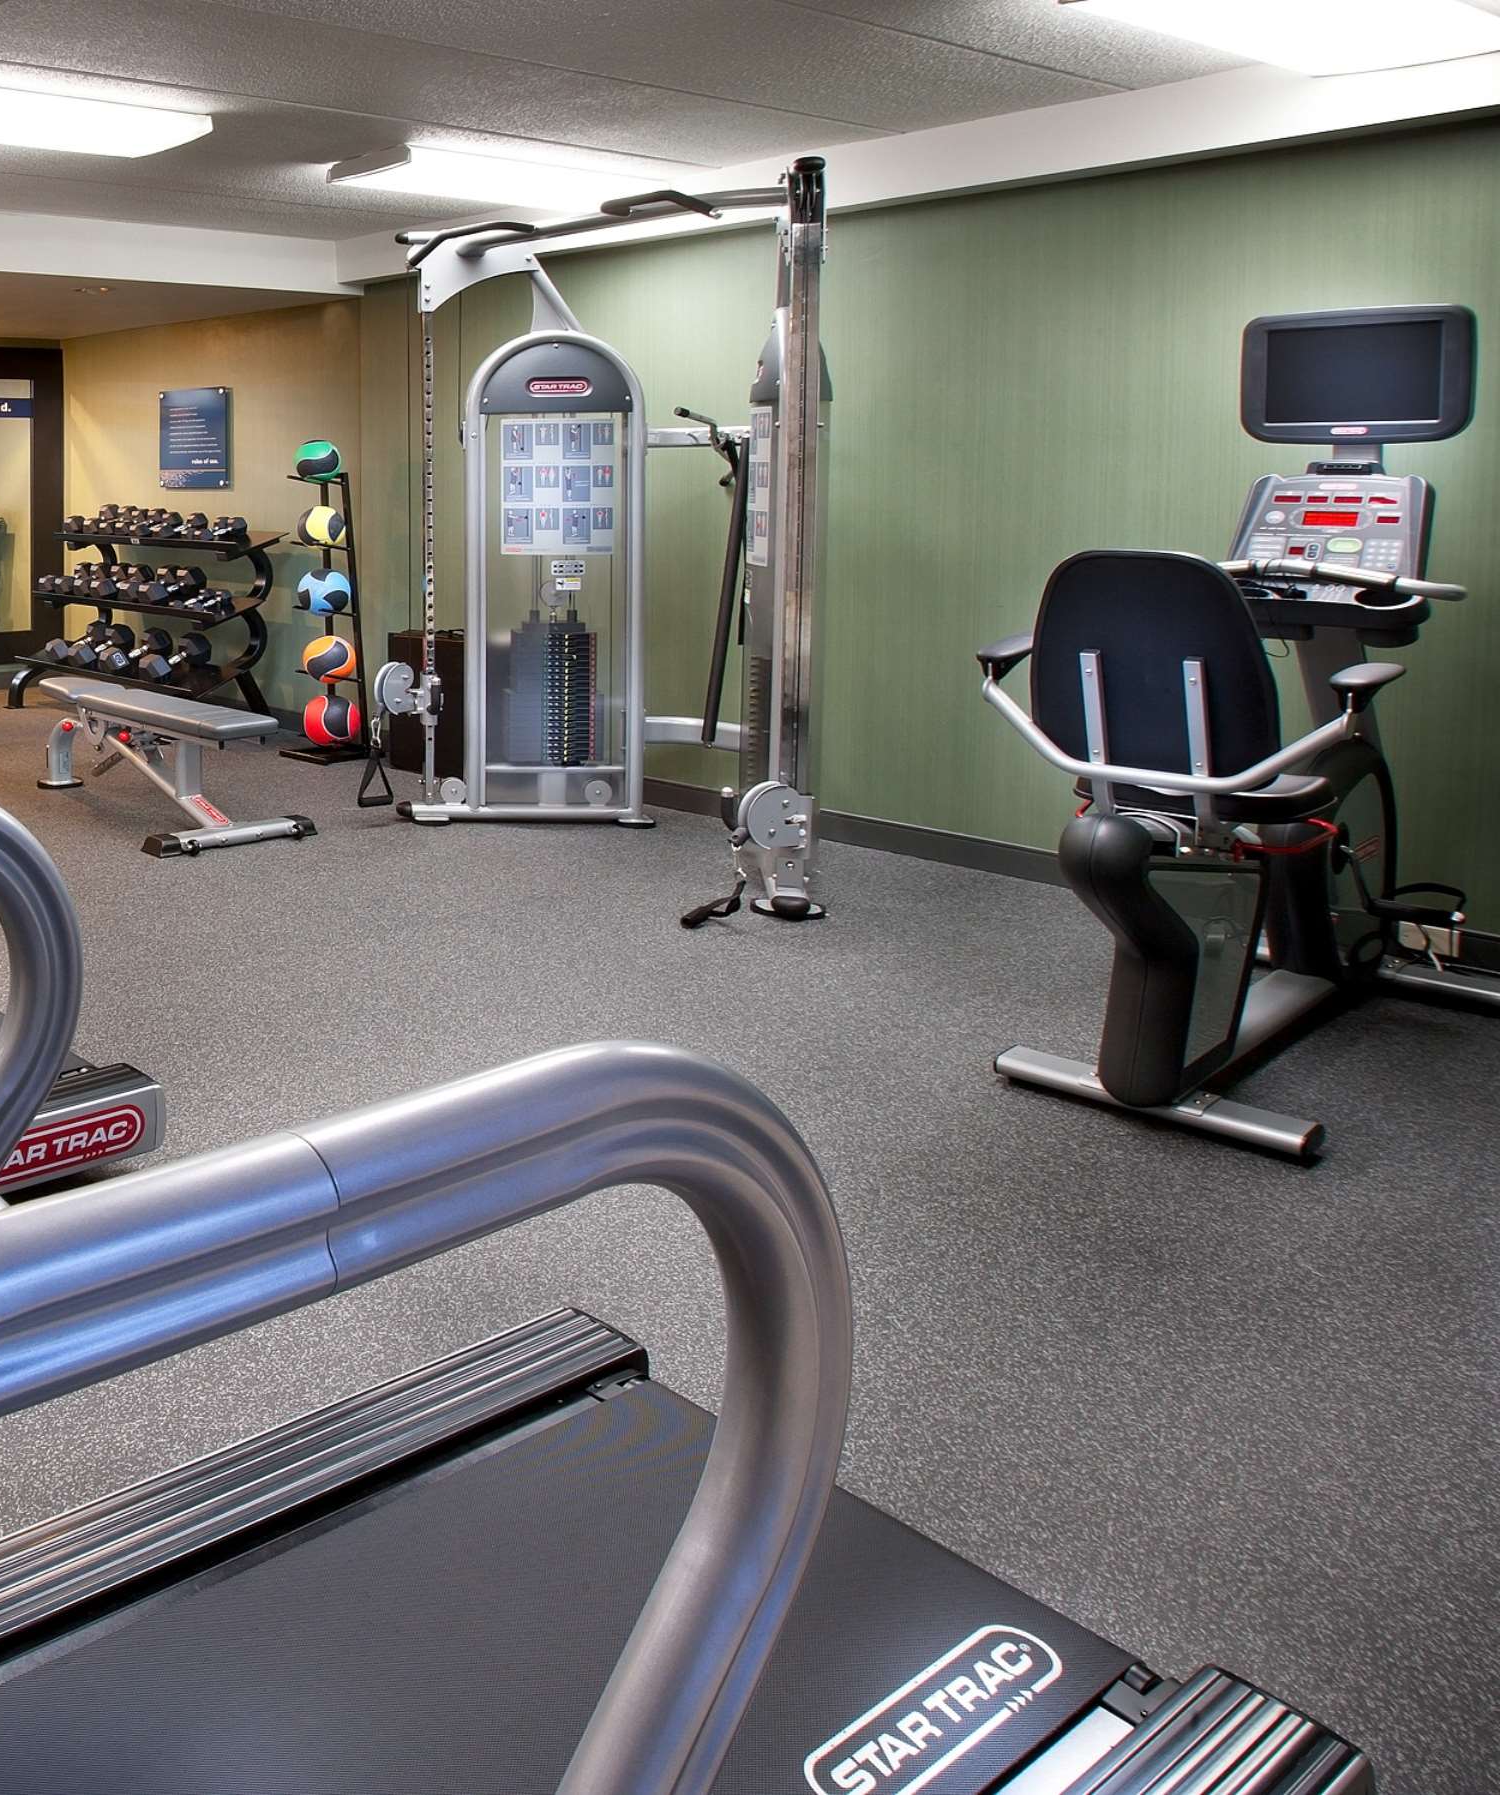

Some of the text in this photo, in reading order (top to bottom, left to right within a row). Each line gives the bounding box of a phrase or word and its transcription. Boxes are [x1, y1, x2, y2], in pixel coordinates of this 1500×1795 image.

[3, 1120, 129, 1170] AR TRAC
[830, 1641, 1034, 1795] STAR TRAC
